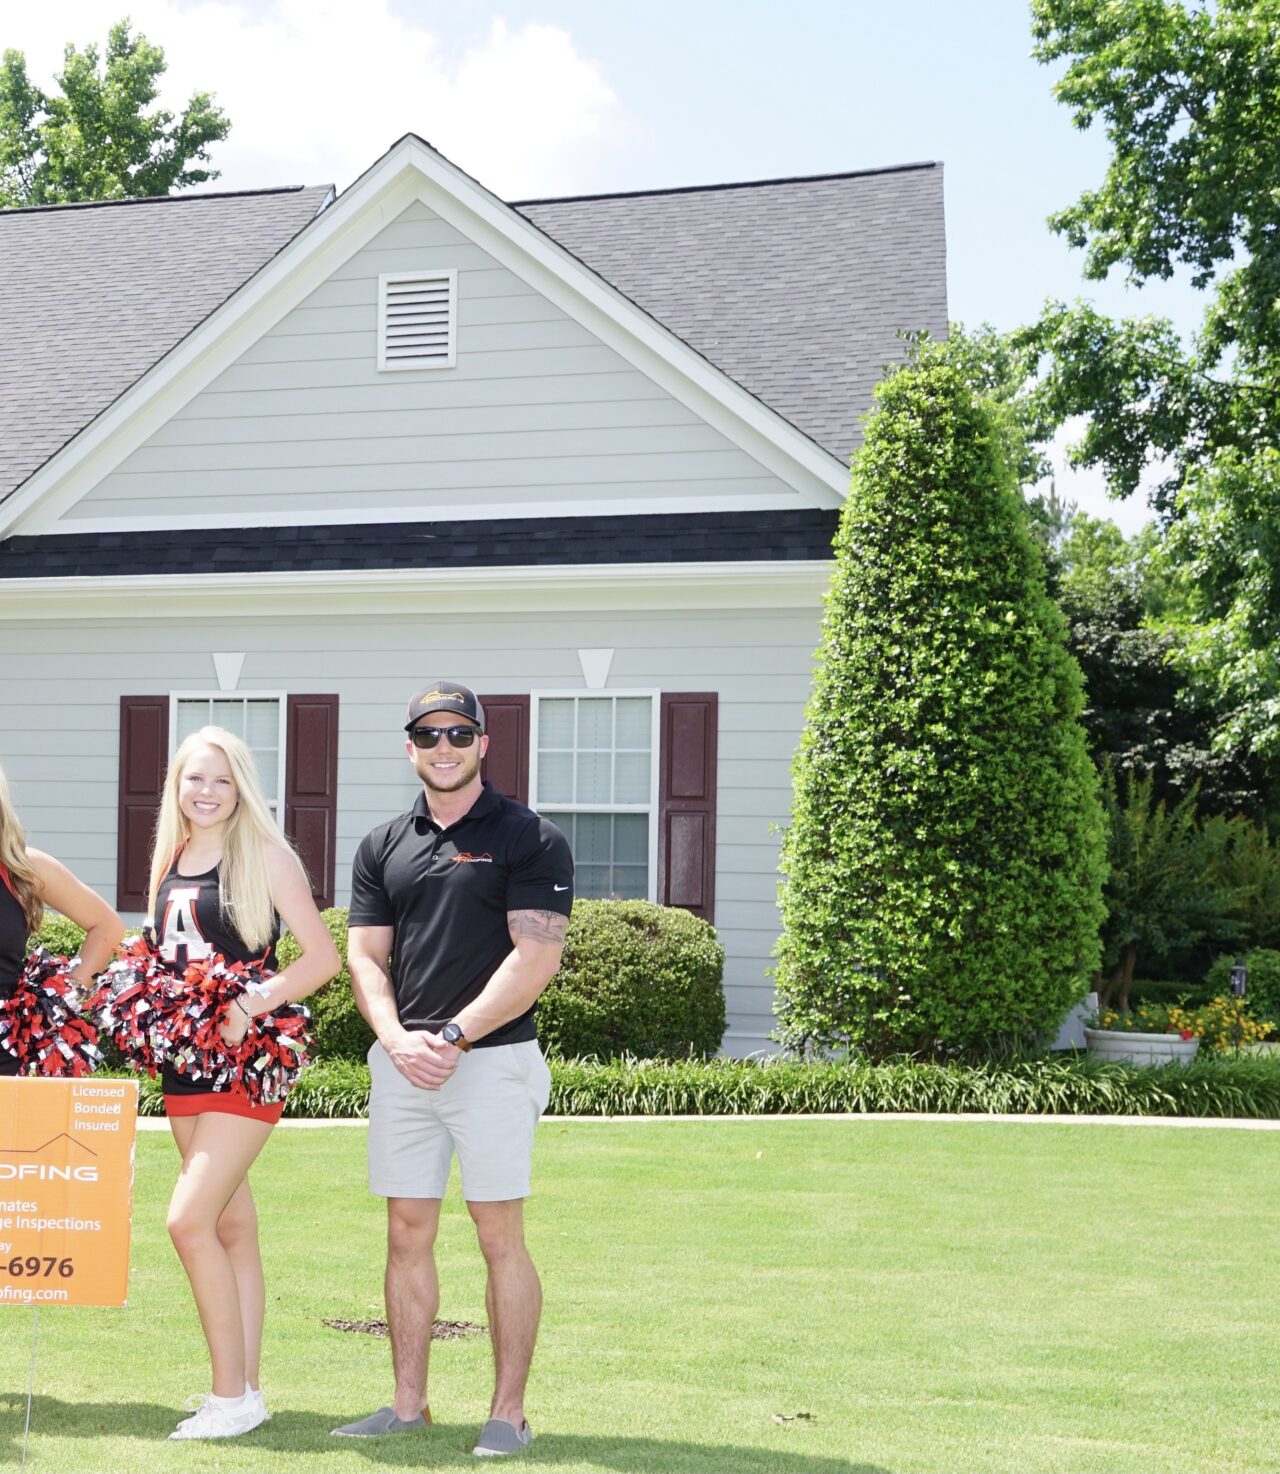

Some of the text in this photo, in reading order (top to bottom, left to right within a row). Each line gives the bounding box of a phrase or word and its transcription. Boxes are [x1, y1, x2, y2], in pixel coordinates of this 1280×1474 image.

[158, 887, 215, 964] A
[73, 1086, 124, 1097] Licensed
[74, 1102, 121, 1114] Bonded
[74, 1120, 119, 1131] Insured
[16, 1215, 101, 1232] Inspections
